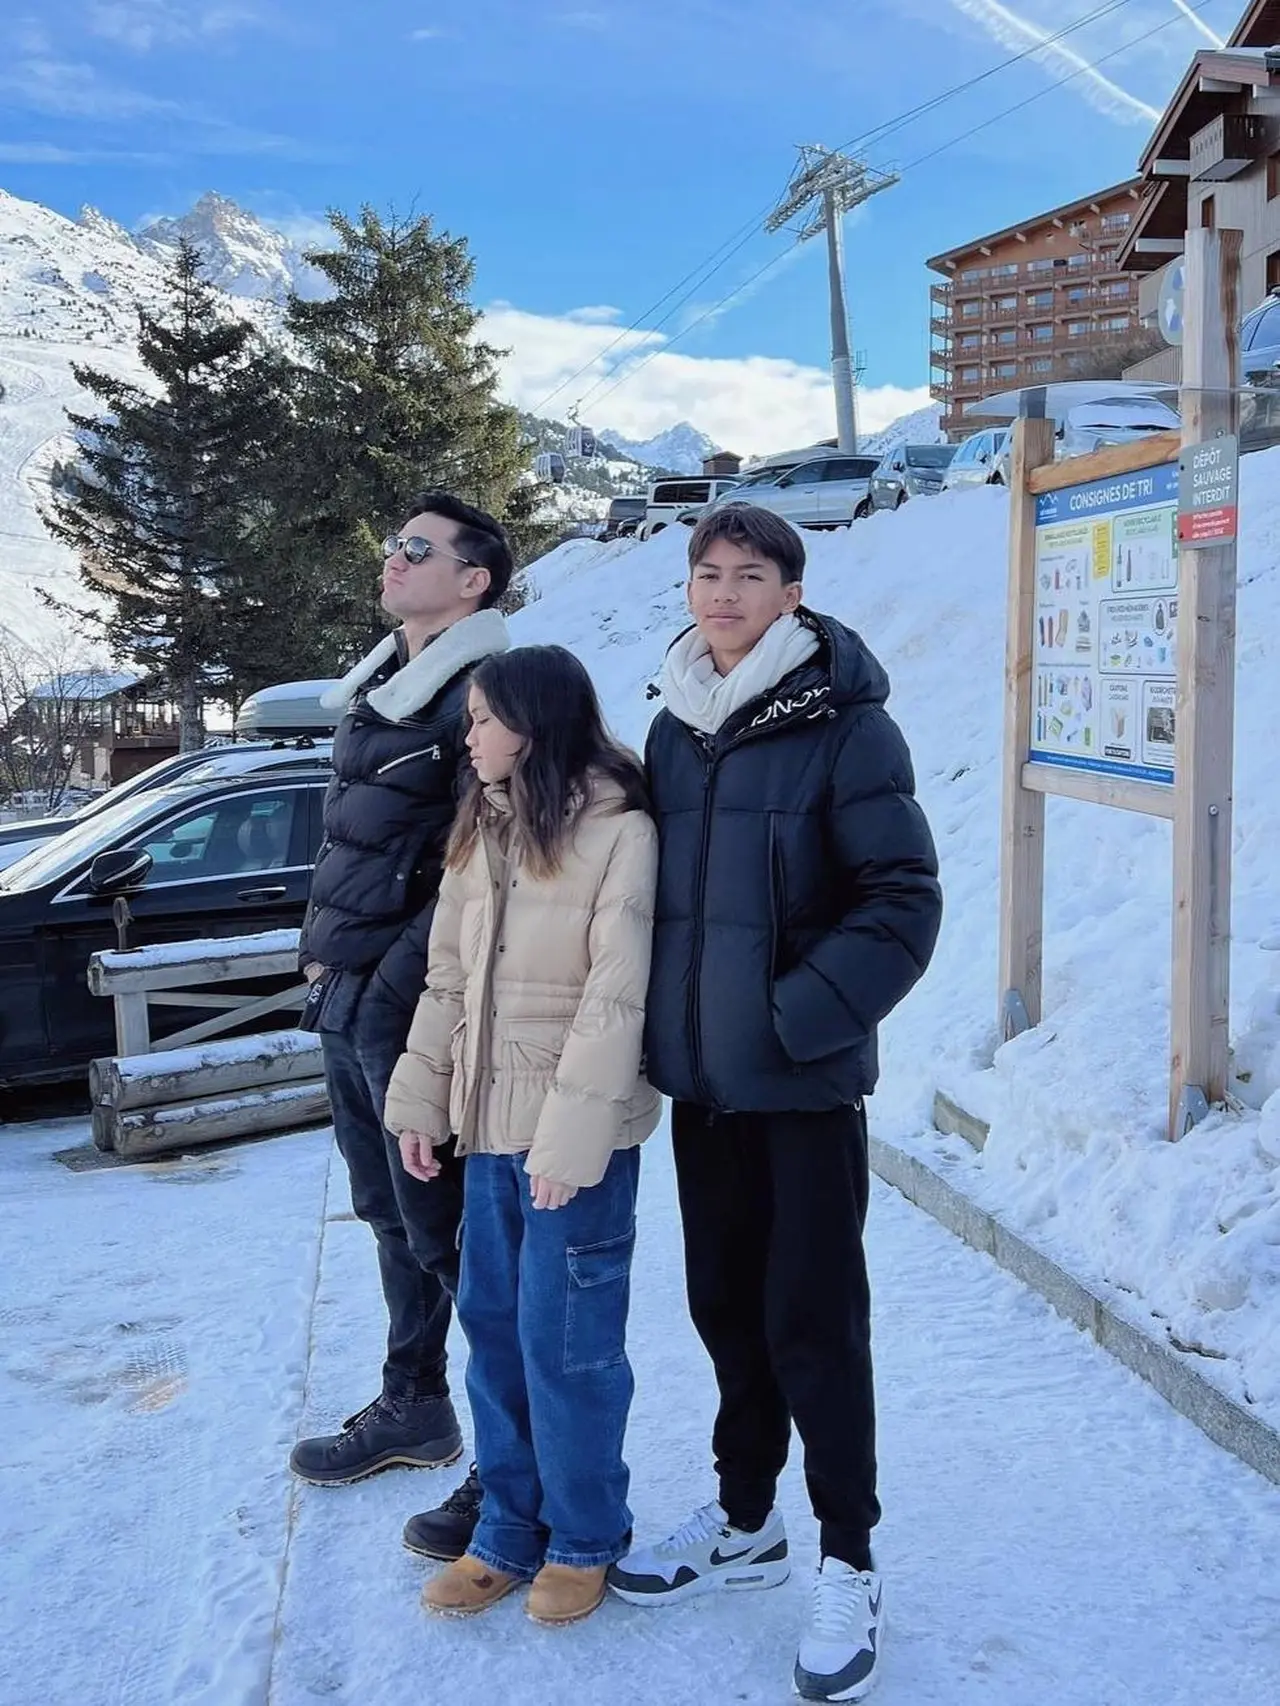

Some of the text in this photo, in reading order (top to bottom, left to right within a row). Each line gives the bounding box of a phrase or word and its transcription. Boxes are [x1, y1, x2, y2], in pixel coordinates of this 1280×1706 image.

[1193, 447, 1222, 469] DÉPÔT
[1193, 466, 1232, 488] SAUVAGE
[1069, 485, 1121, 511] CONSIGNES
[1122, 482, 1136, 501] DE
[1137, 478, 1153, 497] TRI
[1192, 485, 1230, 506] INTERDIT
